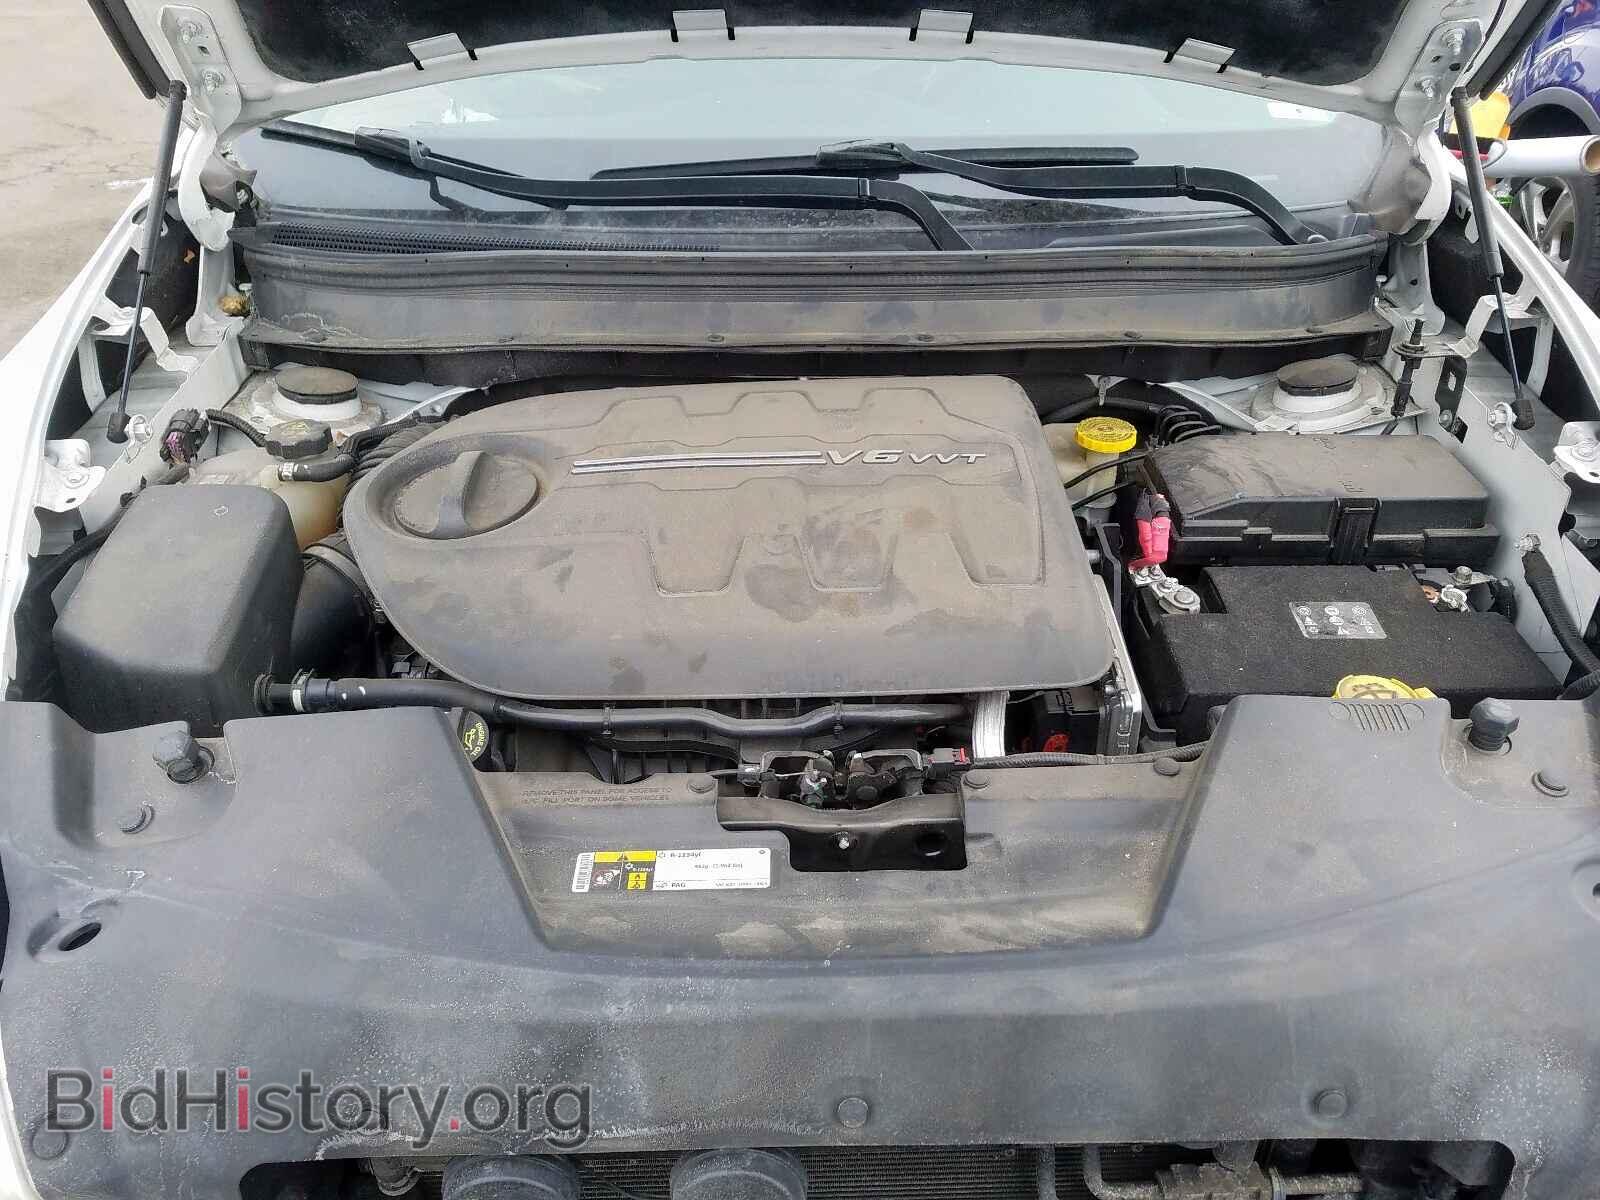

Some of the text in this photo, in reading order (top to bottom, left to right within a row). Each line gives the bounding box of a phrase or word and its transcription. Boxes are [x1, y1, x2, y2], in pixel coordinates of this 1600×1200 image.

[827, 450, 987, 465] V6 VVT
[470, 722, 485, 756] ENGINE OIL
